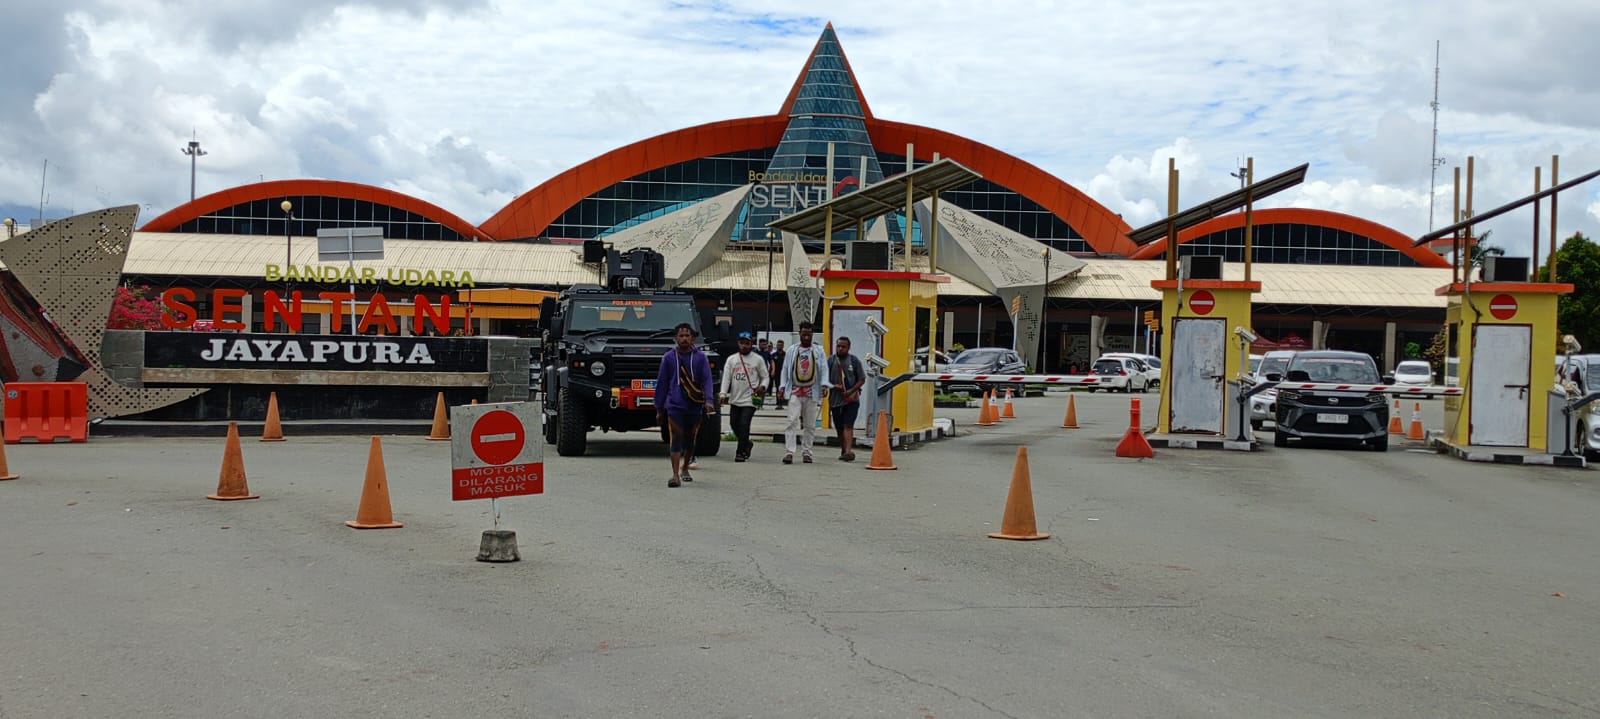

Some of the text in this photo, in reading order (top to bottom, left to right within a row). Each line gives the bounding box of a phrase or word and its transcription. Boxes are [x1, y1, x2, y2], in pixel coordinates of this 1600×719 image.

[748, 170, 796, 181] Bandar
[265, 263, 476, 288] BANDAR UDARA
[200, 338, 436, 366] JAYAPURA
[470, 465, 526, 477] MOTOR
[459, 473, 538, 487] DILARANG
[471, 482, 526, 496] MASUK
